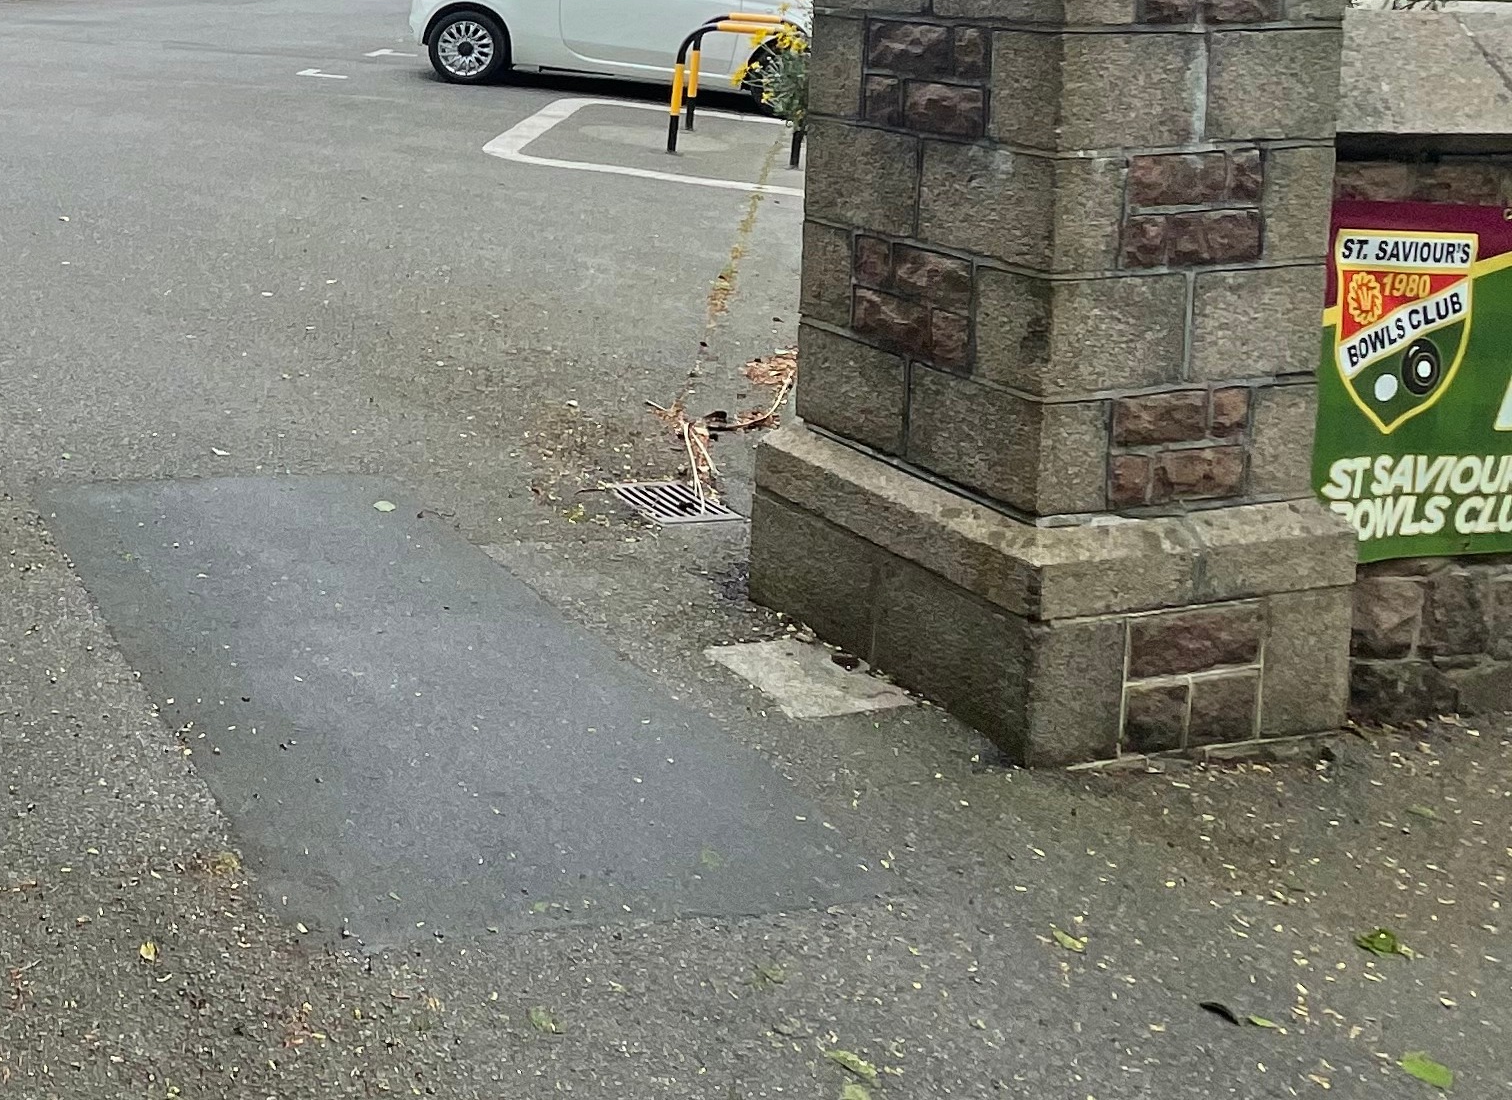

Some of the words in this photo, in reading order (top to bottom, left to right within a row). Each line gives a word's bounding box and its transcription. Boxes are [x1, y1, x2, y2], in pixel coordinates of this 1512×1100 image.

[1341, 238, 1369, 261] ST.
[1375, 240, 1471, 264] SAVIOUR'S
[1382, 273, 1431, 298] 1980
[1346, 317, 1406, 368] BOWLS
[1408, 291, 1463, 331] CLUB
[1320, 456, 1372, 500] ST
